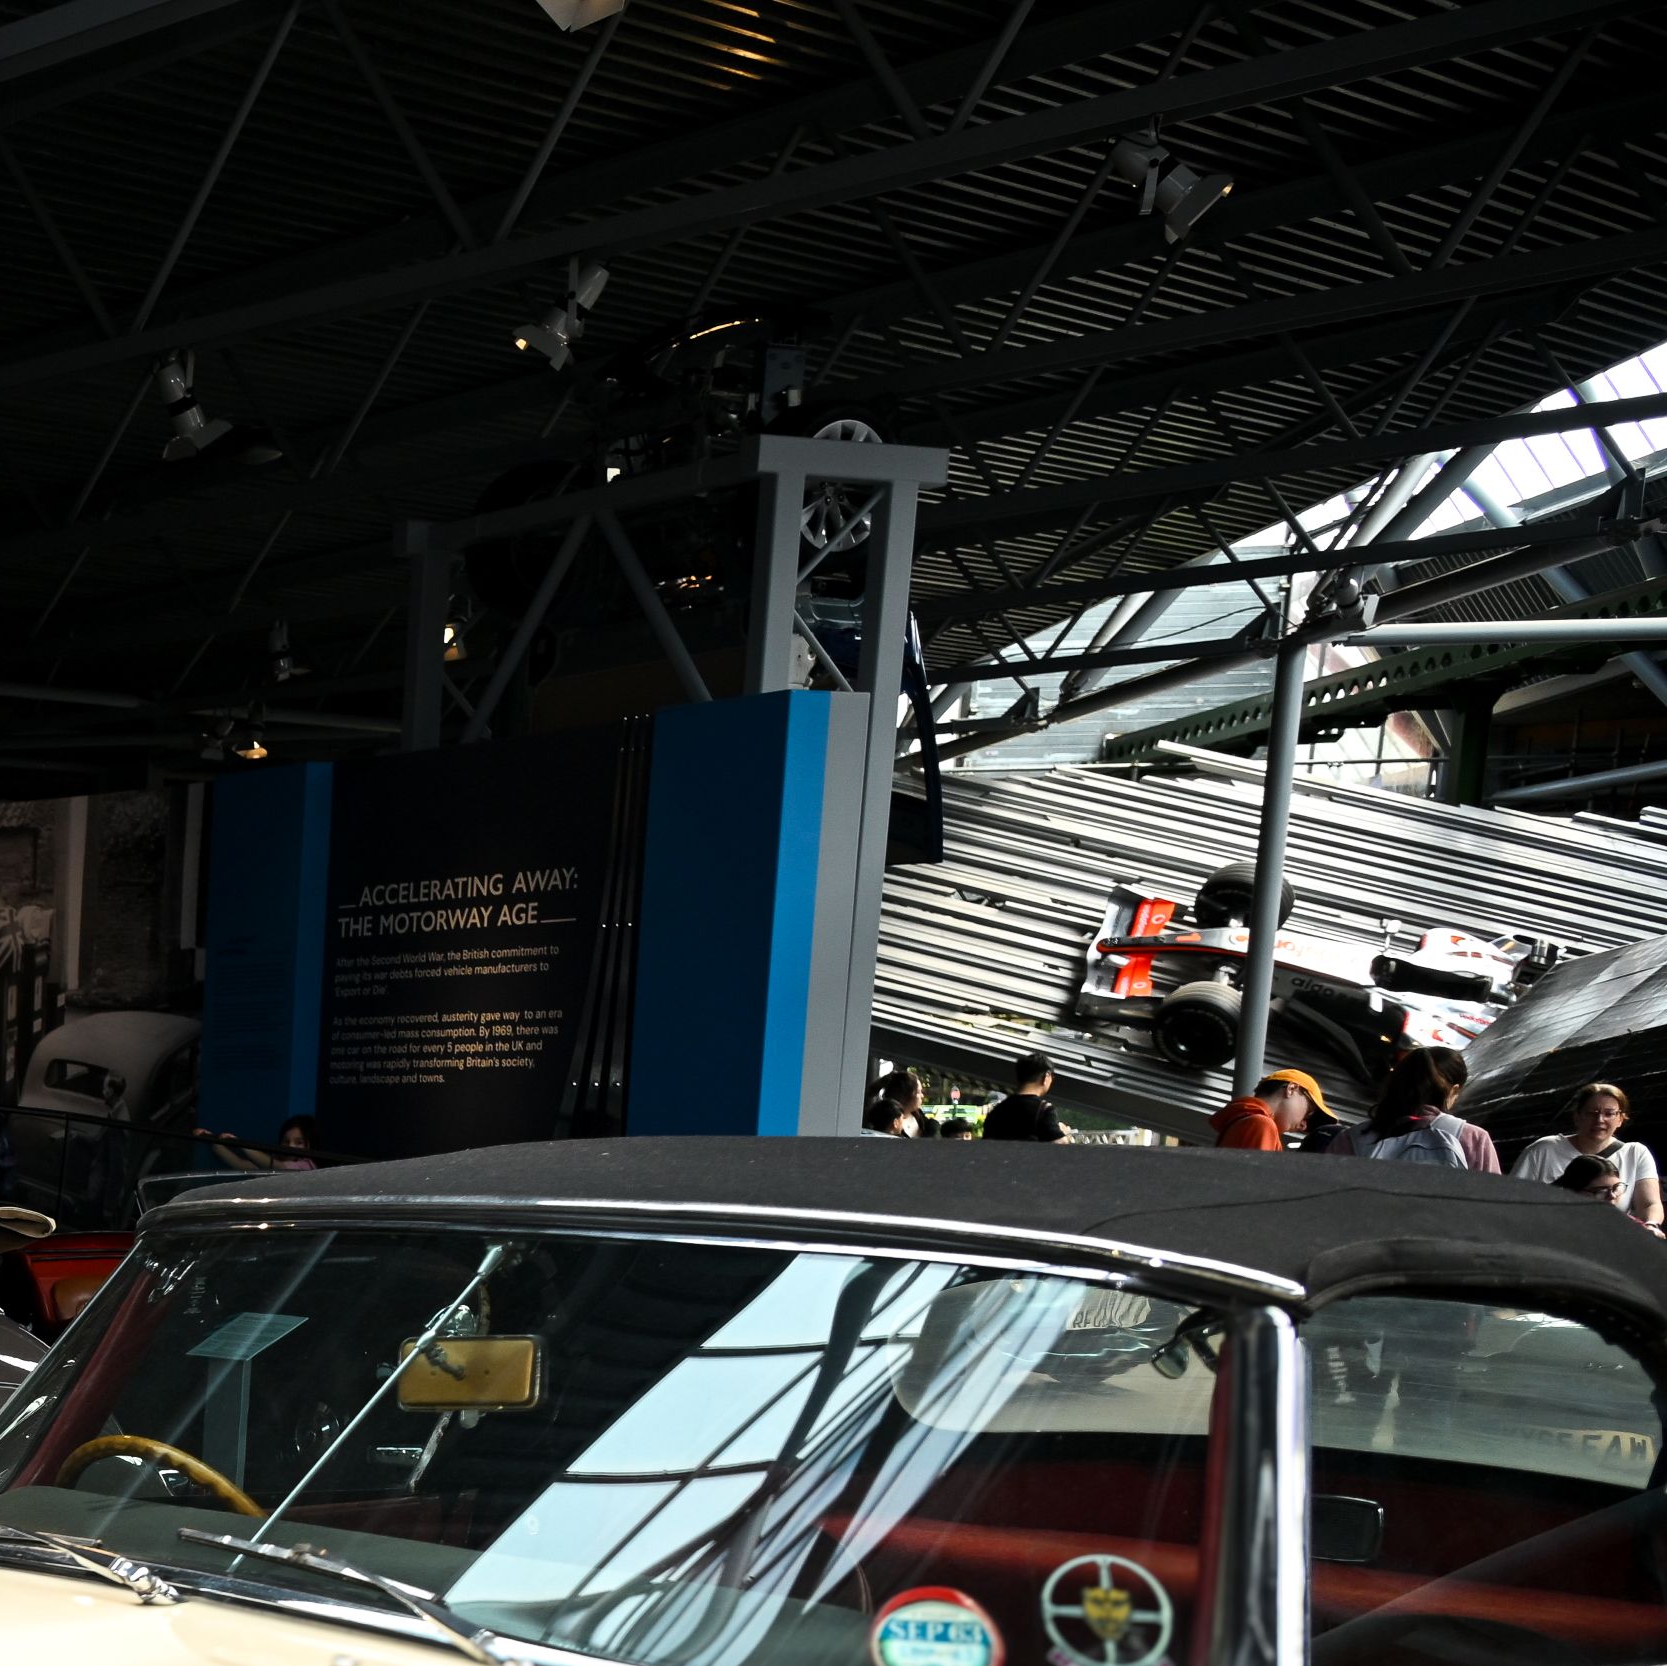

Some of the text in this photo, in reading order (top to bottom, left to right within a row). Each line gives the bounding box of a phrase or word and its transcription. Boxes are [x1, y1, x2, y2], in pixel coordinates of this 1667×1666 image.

[359, 866, 579, 907] ACCELERATING AWAY:
[337, 901, 539, 938] THE MOTORWAY AGE
[402, 952, 426, 964] World
[447, 950, 461, 961] the
[462, 947, 490, 960] British
[491, 945, 547, 959] commitment
[549, 944, 560, 955] to
[390, 967, 414, 980] debts
[415, 966, 442, 978] forced
[444, 964, 473, 977] vehicle
[474, 961, 538, 975] manufacturers
[539, 960, 550, 972] to
[441, 1010, 479, 1024] austerity
[480, 1011, 501, 1024] gave
[502, 1010, 521, 1023] way
[524, 1010, 534, 1020] to
[536, 1010, 547, 1019] an
[548, 1009, 563, 1019] era
[398, 1028, 420, 1039] mass
[421, 1026, 478, 1040] consumption.
[479, 1025, 491, 1038] By
[492, 1024, 514, 1037] 1969,
[516, 1024, 540, 1036] there
[541, 1025, 559, 1035] was
[373, 1042, 388, 1054] the
[388, 1042, 408, 1053] road
[409, 1041, 420, 1053] for
[421, 1042, 445, 1055] every
[446, 1041, 453, 1052] 5
[454, 1040, 484, 1055] people
[485, 1040, 494, 1051] in
[495, 1040, 510, 1051] the
[511, 1039, 524, 1051] UK
[525, 1039, 543, 1050] and
[412, 1056, 465, 1071] transforming
[466, 1056, 500, 1069] Britain's
[501, 1056, 536, 1069] society,
[401, 1071, 418, 1083] and
[419, 1071, 446, 1083] towns.
[888, 1620, 983, 1644] SEP 63
